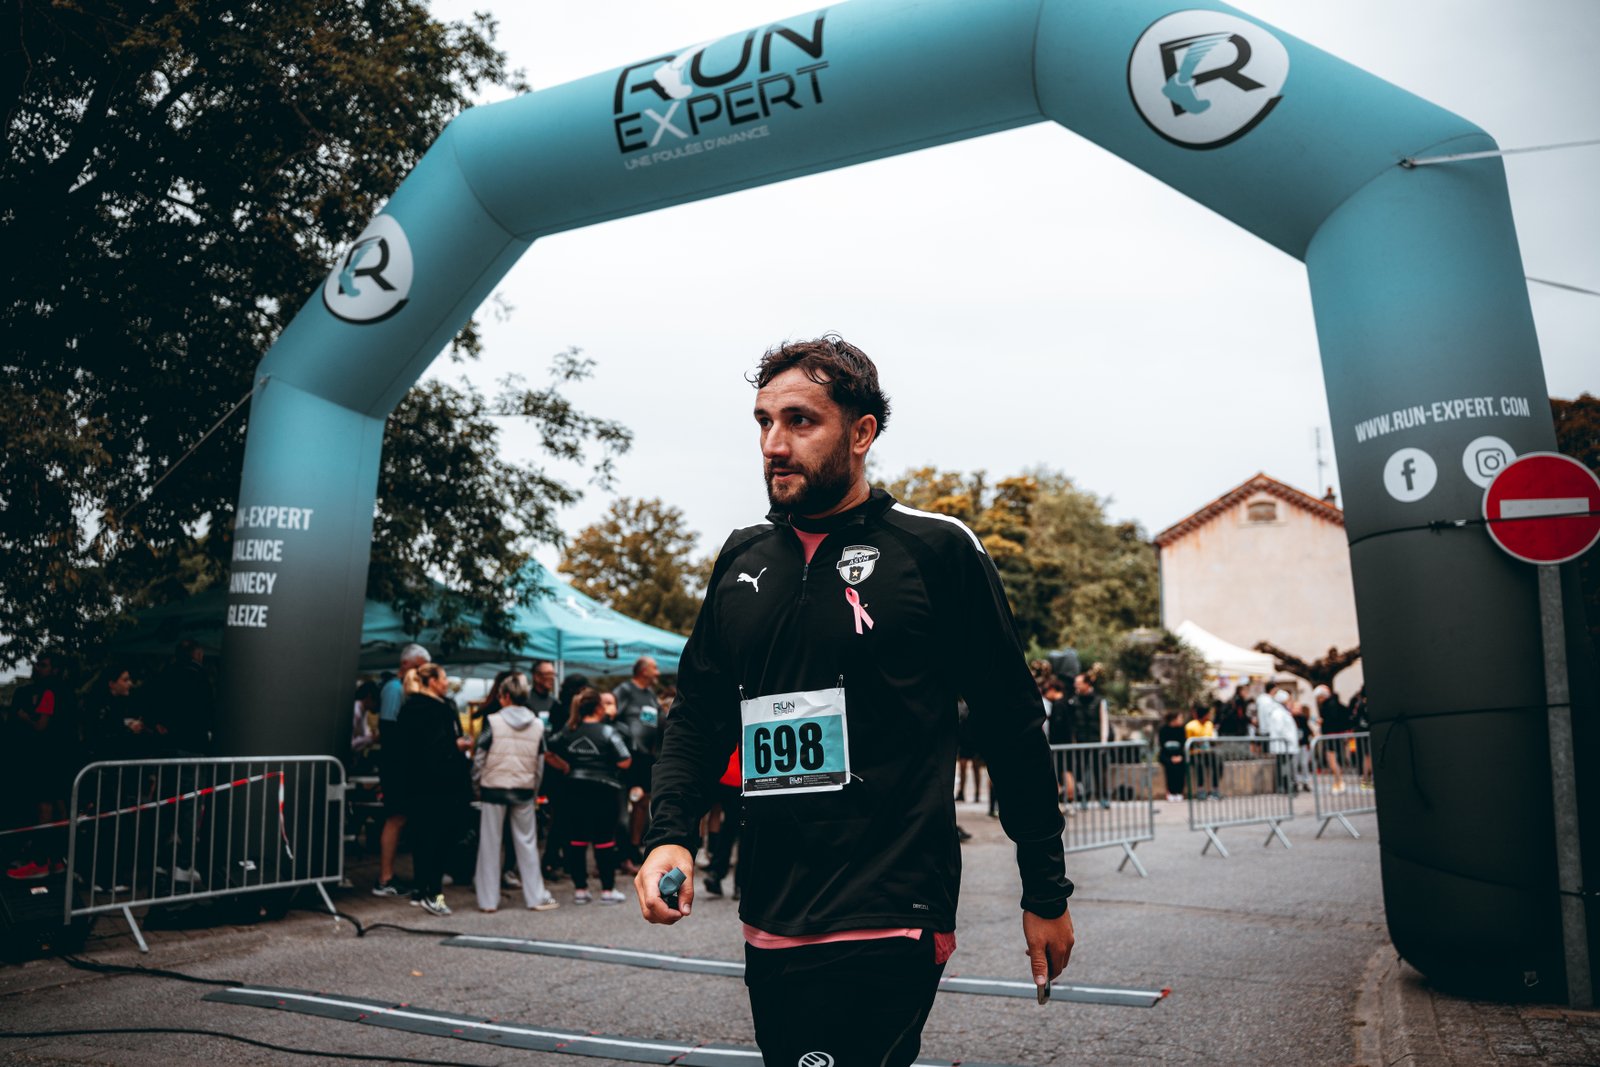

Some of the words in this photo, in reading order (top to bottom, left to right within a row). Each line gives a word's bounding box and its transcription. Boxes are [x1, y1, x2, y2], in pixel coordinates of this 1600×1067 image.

[614, 11, 828, 115] RUN
[614, 61, 829, 154] EXPERT
[625, 155, 652, 170] UNE
[706, 125, 770, 149] D'AVANCE
[773, 700, 795, 711] RUN
[754, 722, 824, 774] 698
